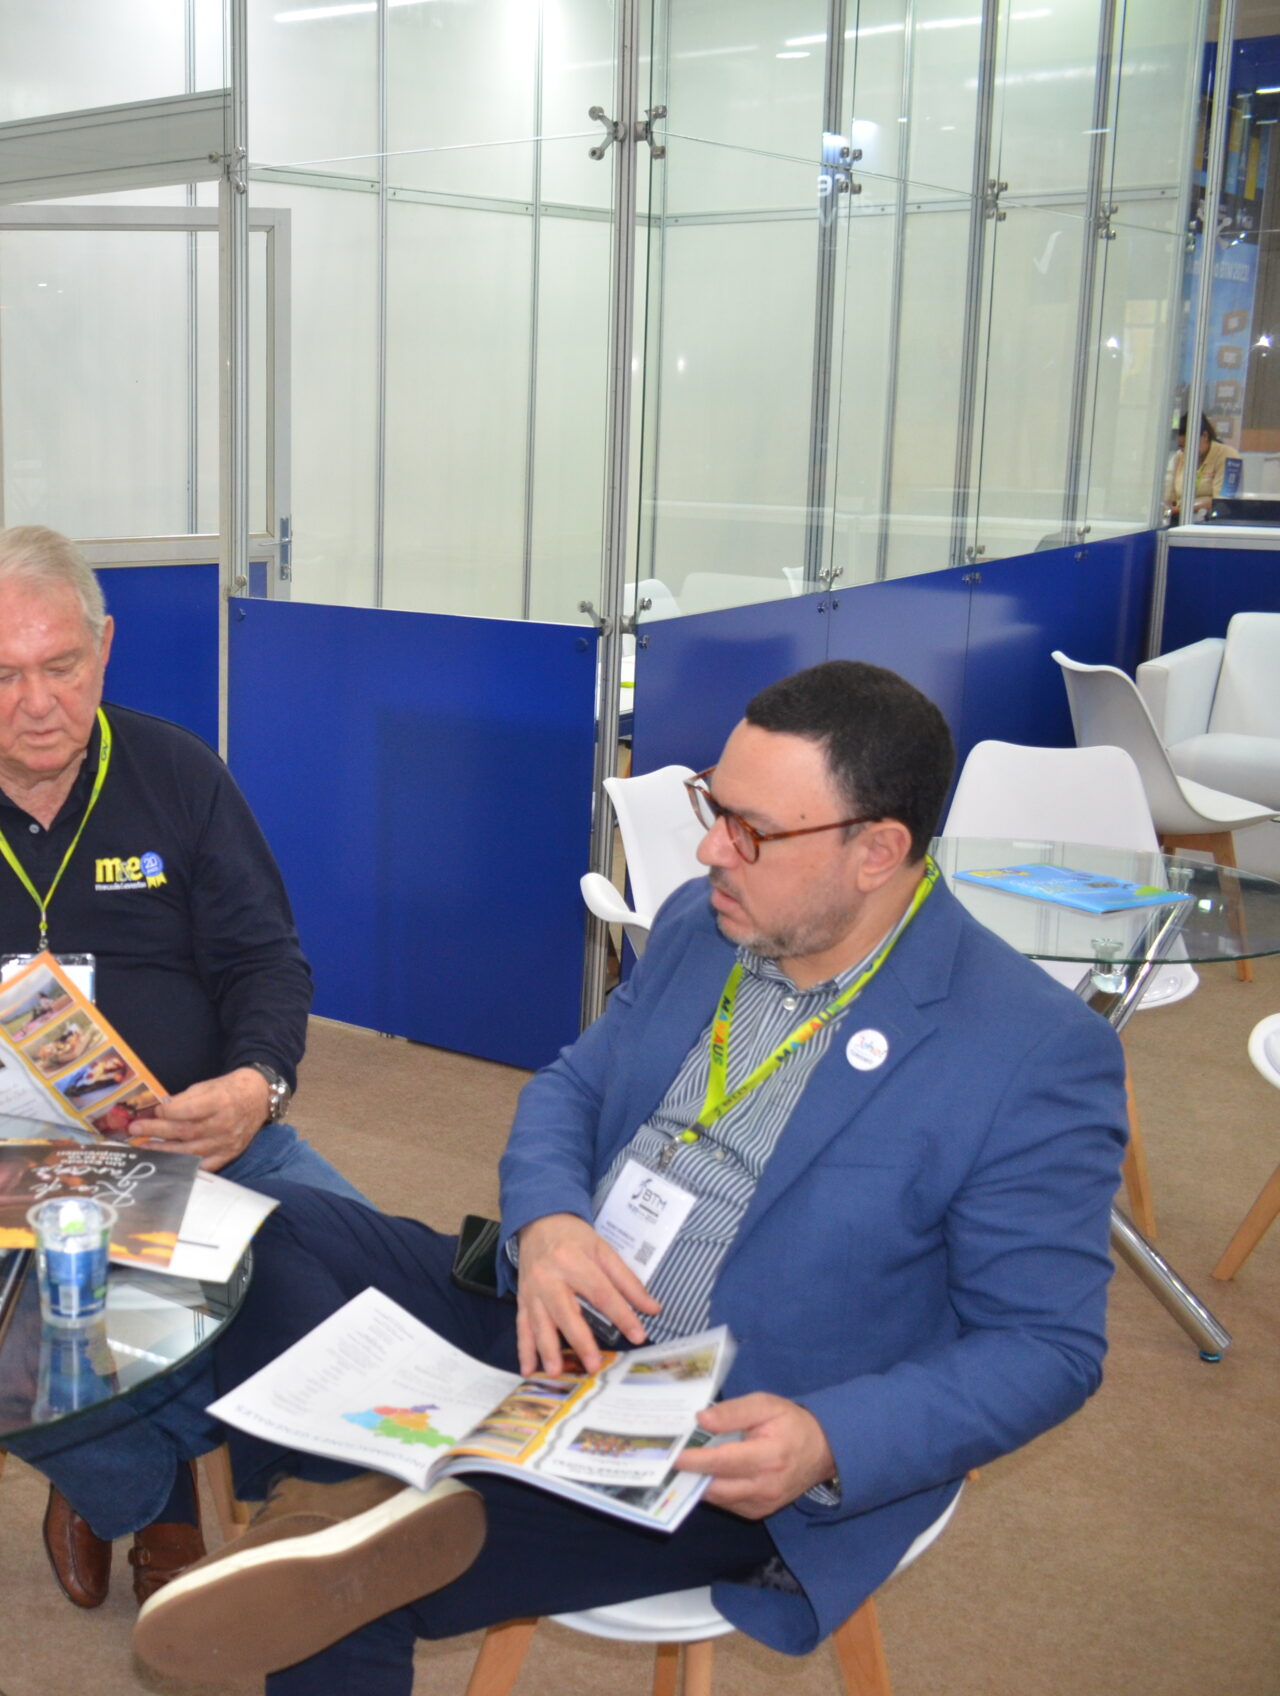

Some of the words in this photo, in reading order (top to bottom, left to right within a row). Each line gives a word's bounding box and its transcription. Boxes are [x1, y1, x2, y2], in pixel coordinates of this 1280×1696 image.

[95, 856, 143, 883] m&e
[144, 858, 158, 870] 20
[712, 995, 730, 1067] MANAUS
[776, 1002, 840, 1062] MANAUS
[642, 1188, 667, 1211] BTM
